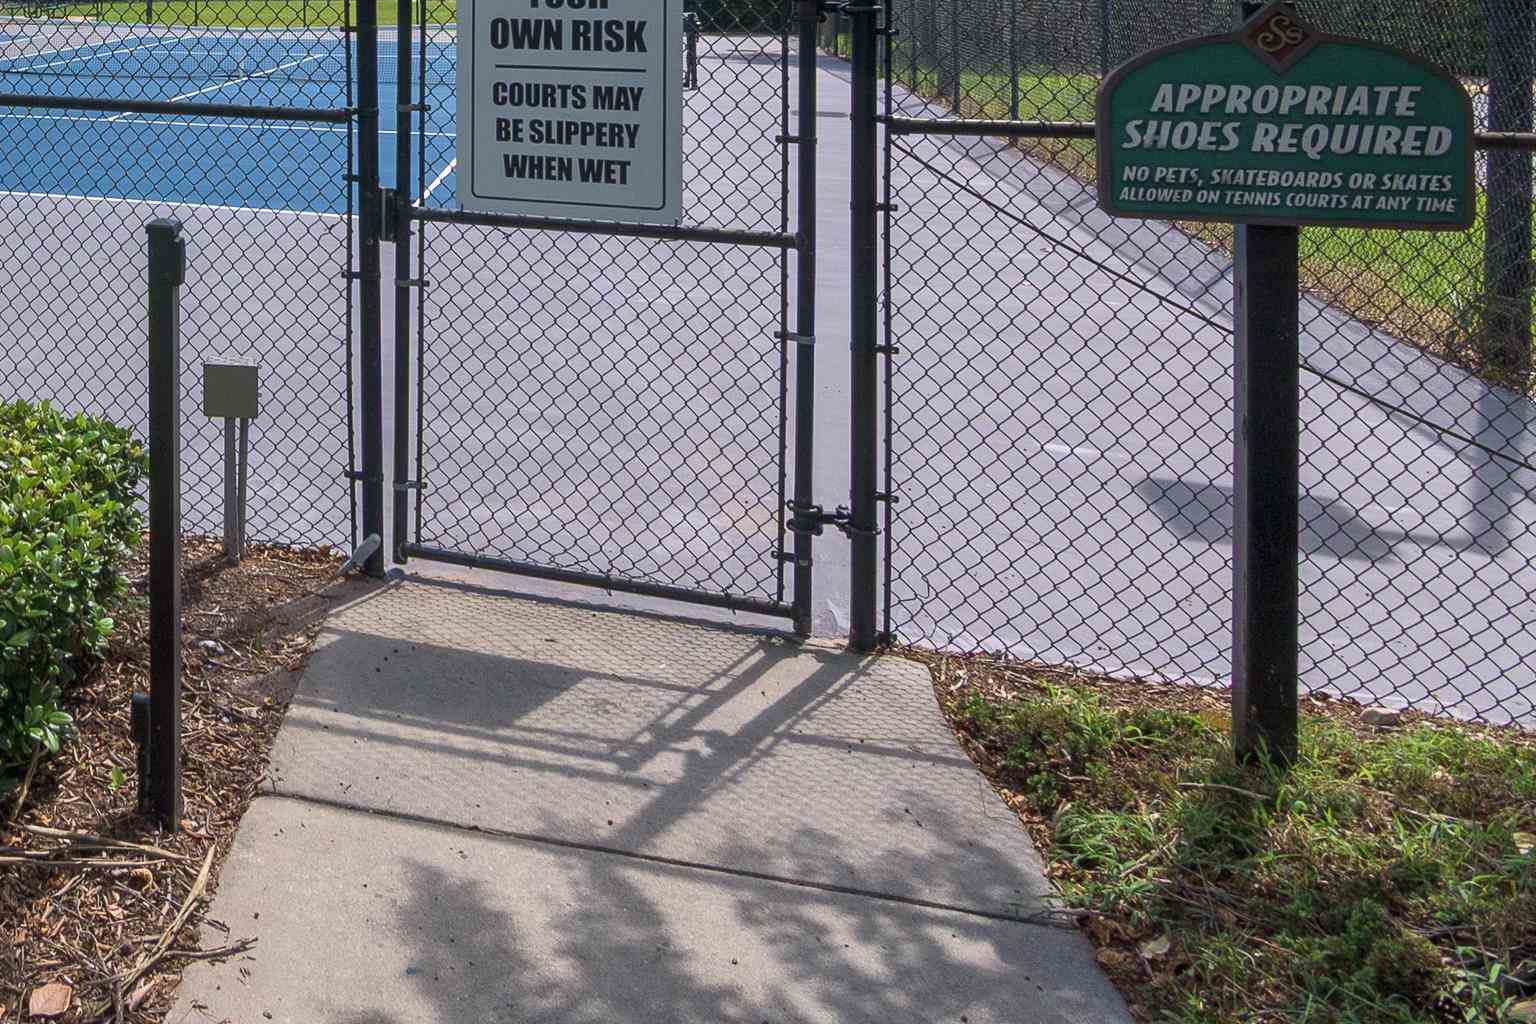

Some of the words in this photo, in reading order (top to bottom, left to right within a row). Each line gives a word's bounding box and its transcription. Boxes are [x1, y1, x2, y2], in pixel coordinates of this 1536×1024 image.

[489, 17, 563, 51] OWN
[571, 19, 648, 53] RISK
[492, 81, 587, 110] COURTS
[592, 85, 644, 111] MAY
[1149, 83, 1422, 117] APPROPRIATE
[495, 117, 524, 143] BE
[529, 119, 640, 148] SLIPPERY
[1121, 119, 1241, 151] SHOES
[1250, 122, 1453, 161] REQUIRED
[503, 153, 573, 182] WHEN
[578, 158, 631, 185] WET
[1121, 165, 1150, 183] NO
[1154, 166, 1204, 188] PETS,
[1210, 168, 1344, 189] SKATEBOARDS
[1348, 172, 1378, 190] OR
[1380, 174, 1453, 192] SKATES
[1119, 186, 1193, 203] ALLOWED
[1195, 190, 1220, 205] ON
[1224, 190, 1282, 207] TENNIS
[1285, 192, 1350, 209] COURTS
[1351, 194, 1375, 210] AT
[1375, 195, 1412, 212] ANY
[1415, 196, 1457, 213] TIME
